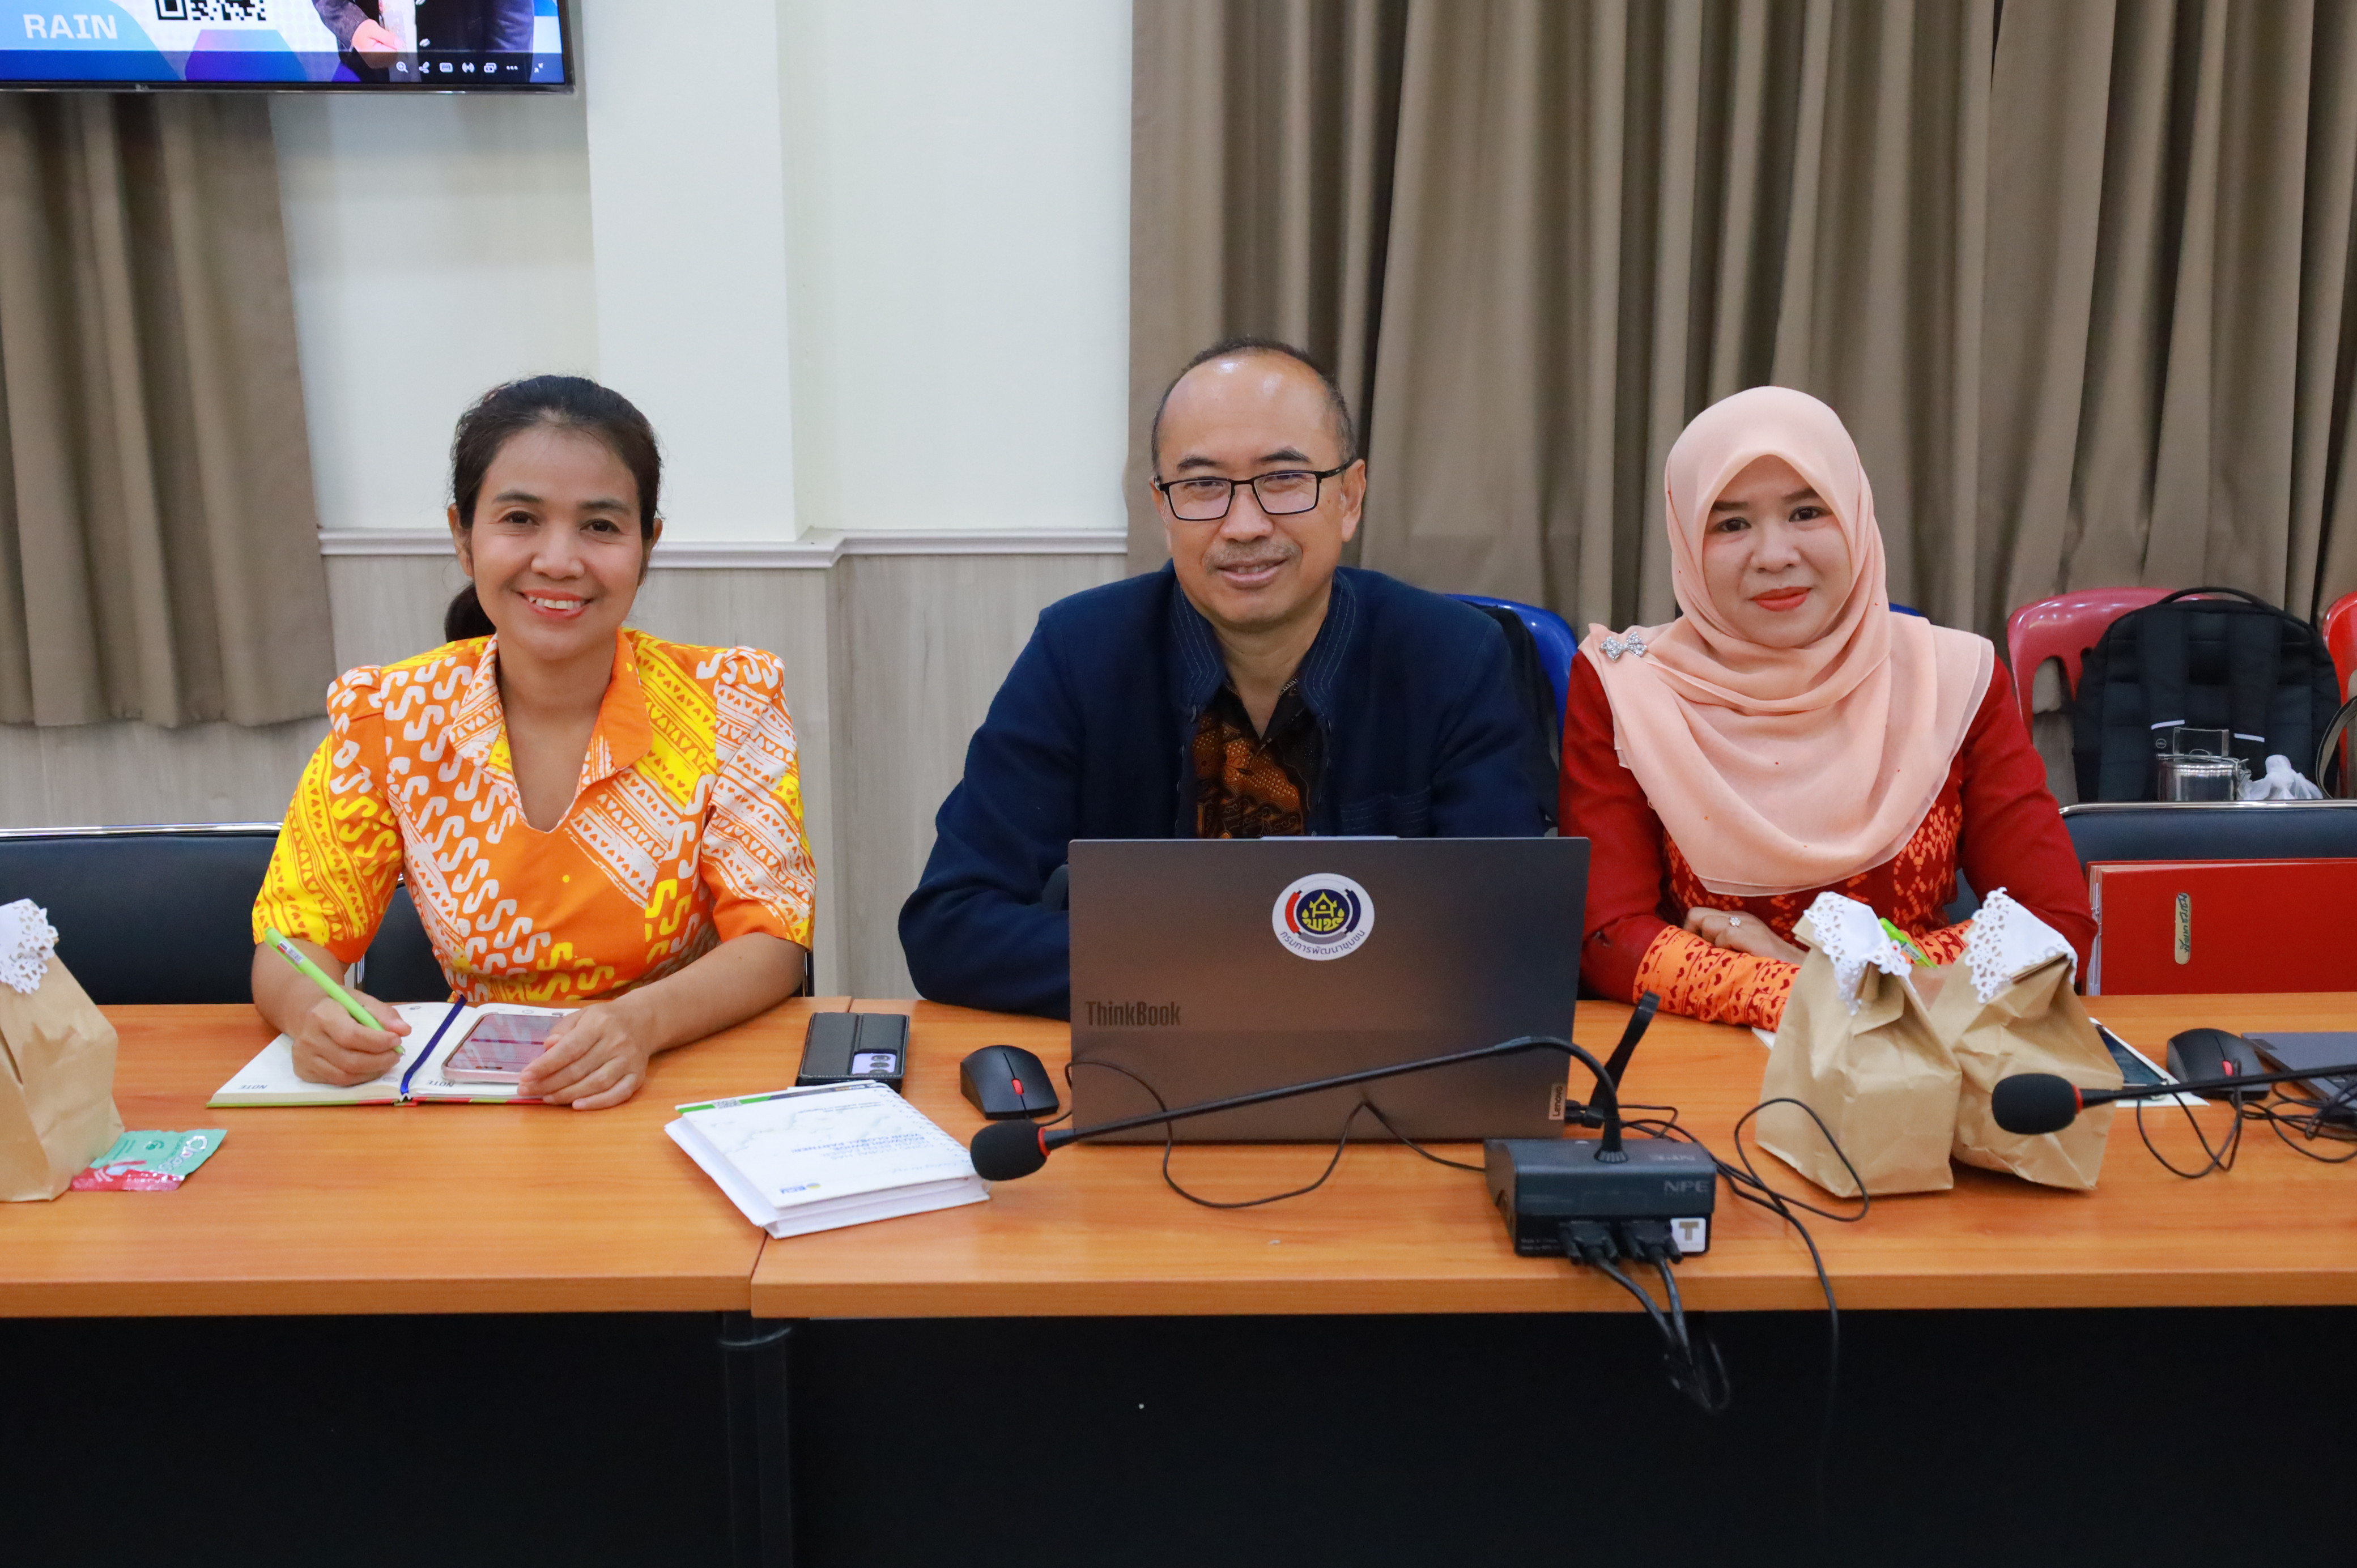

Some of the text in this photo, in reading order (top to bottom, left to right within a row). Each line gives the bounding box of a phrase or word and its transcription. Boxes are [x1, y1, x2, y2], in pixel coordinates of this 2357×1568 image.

[23, 14, 118, 39] RAIN
[1280, 930, 1366, 955] กรมการพัฒนาชุมชน
[1084, 1001, 1181, 1026] ThinkBook
[1552, 1086, 1563, 1117] Lenovo
[1663, 1179, 1710, 1194] NPE
[1679, 1221, 1699, 1241] T
